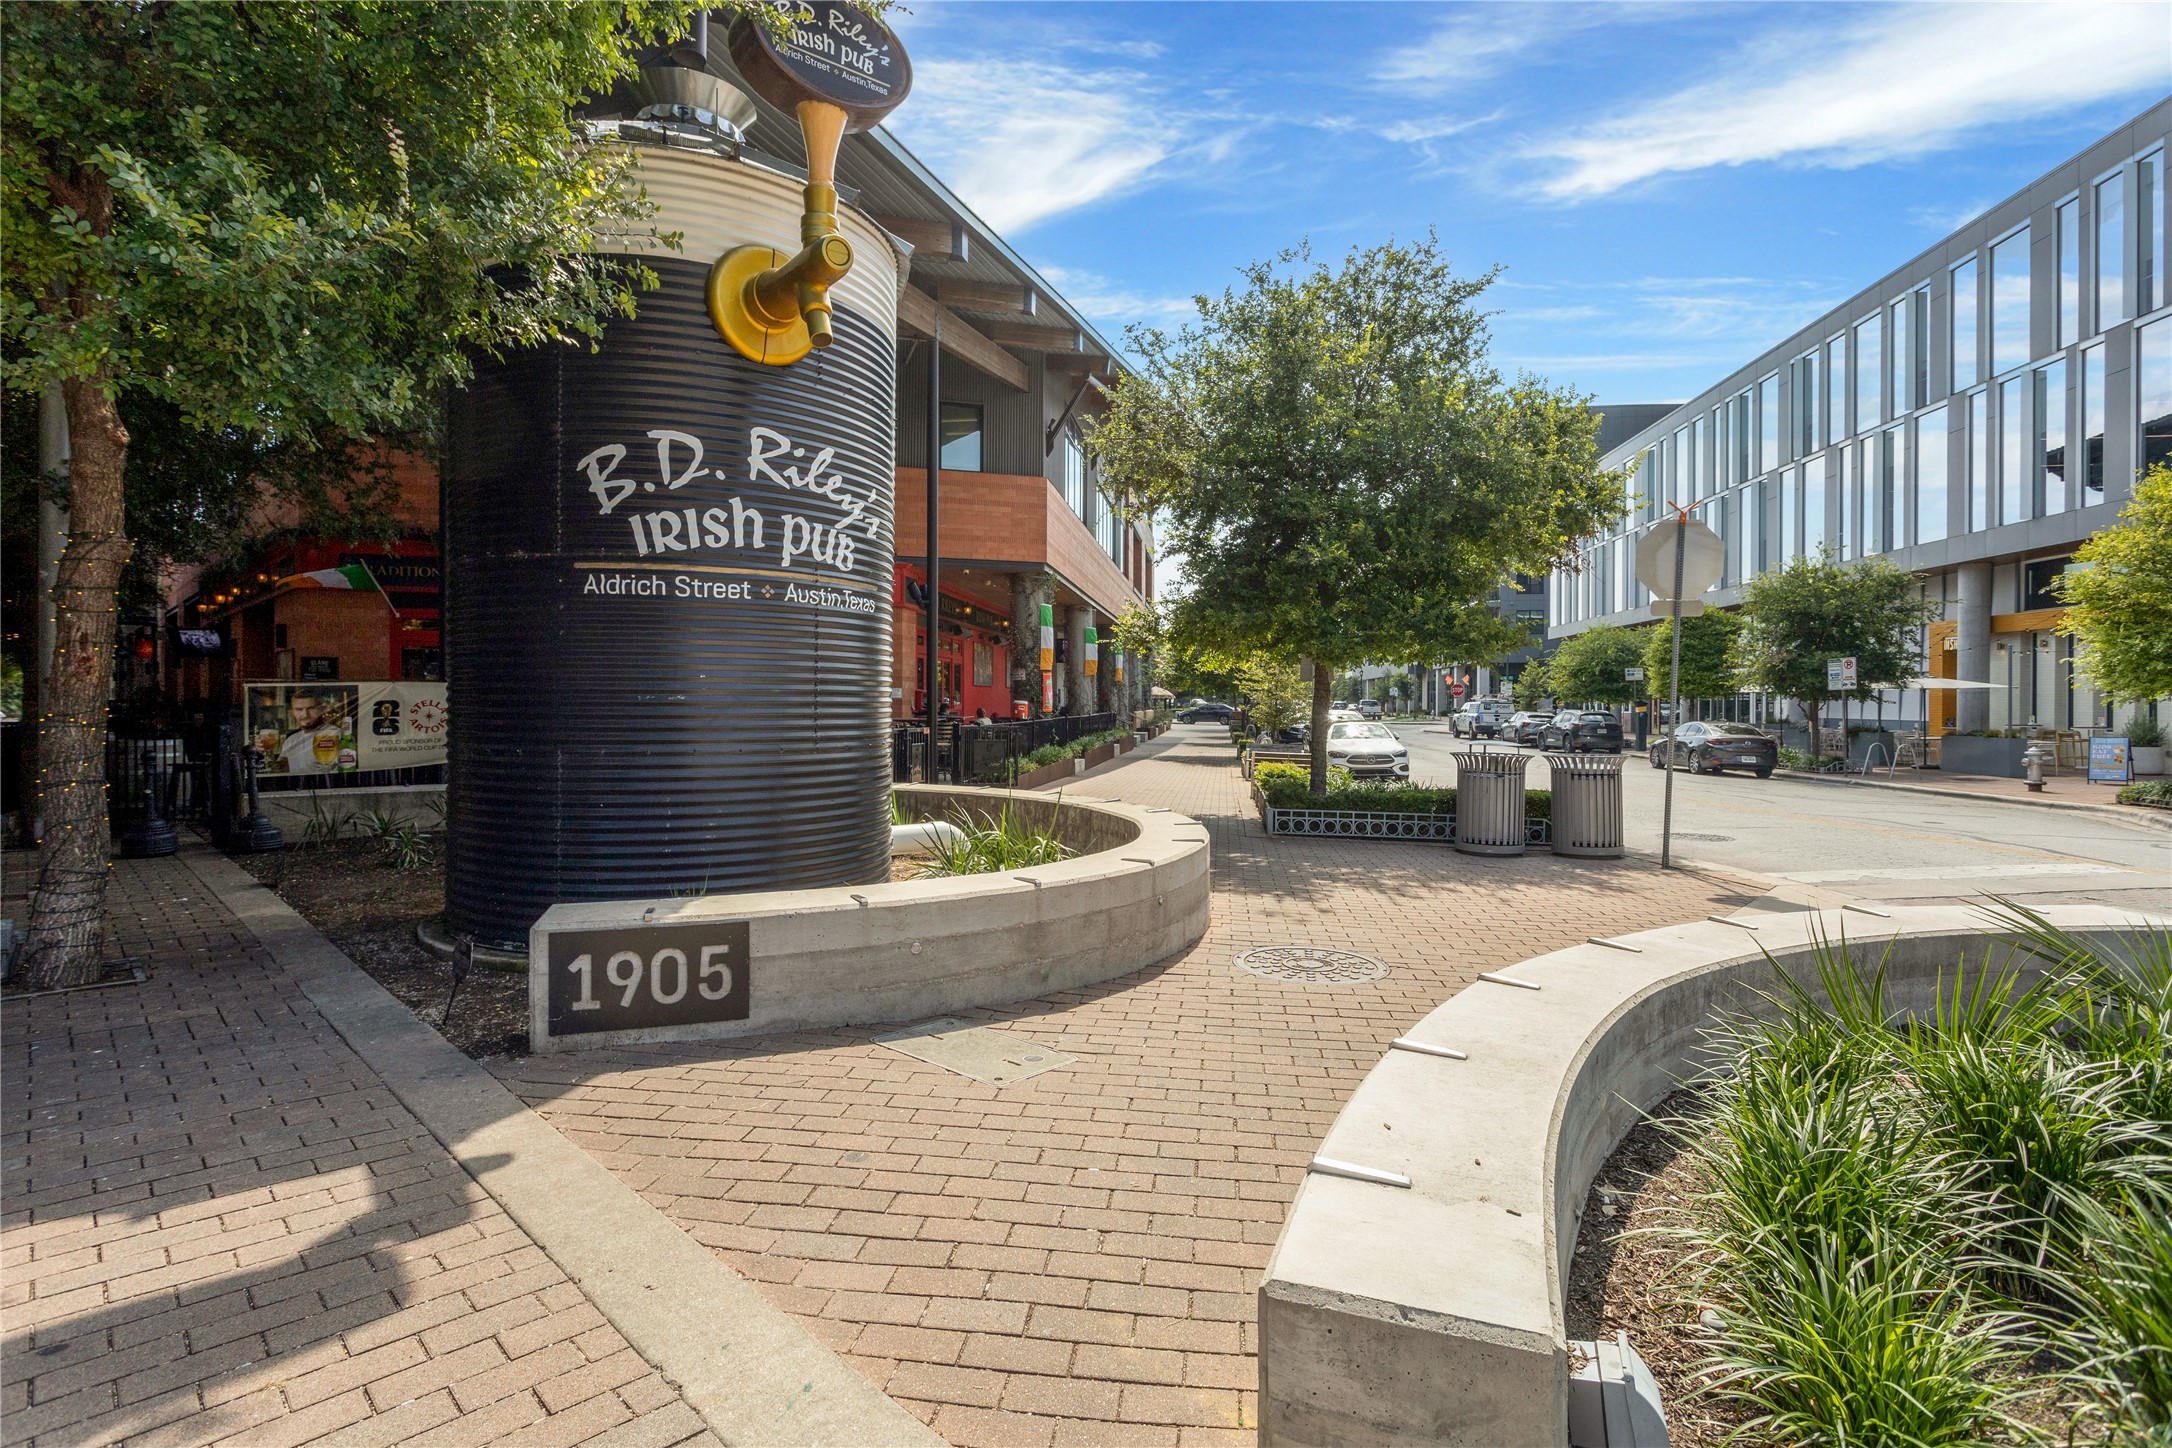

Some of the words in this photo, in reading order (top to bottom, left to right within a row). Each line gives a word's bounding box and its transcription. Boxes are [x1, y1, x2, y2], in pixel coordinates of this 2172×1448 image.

[828, 8, 890, 67] Riley's
[804, 54, 831, 73] Street
[576, 429, 726, 515] B.D.
[748, 426, 880, 539] Riley's
[583, 573, 666, 596] Aldrich
[674, 575, 752, 600] Street
[411, 700, 448, 714] STELLA
[410, 718, 448, 733] ARTOIS
[567, 944, 733, 1012] 1905
